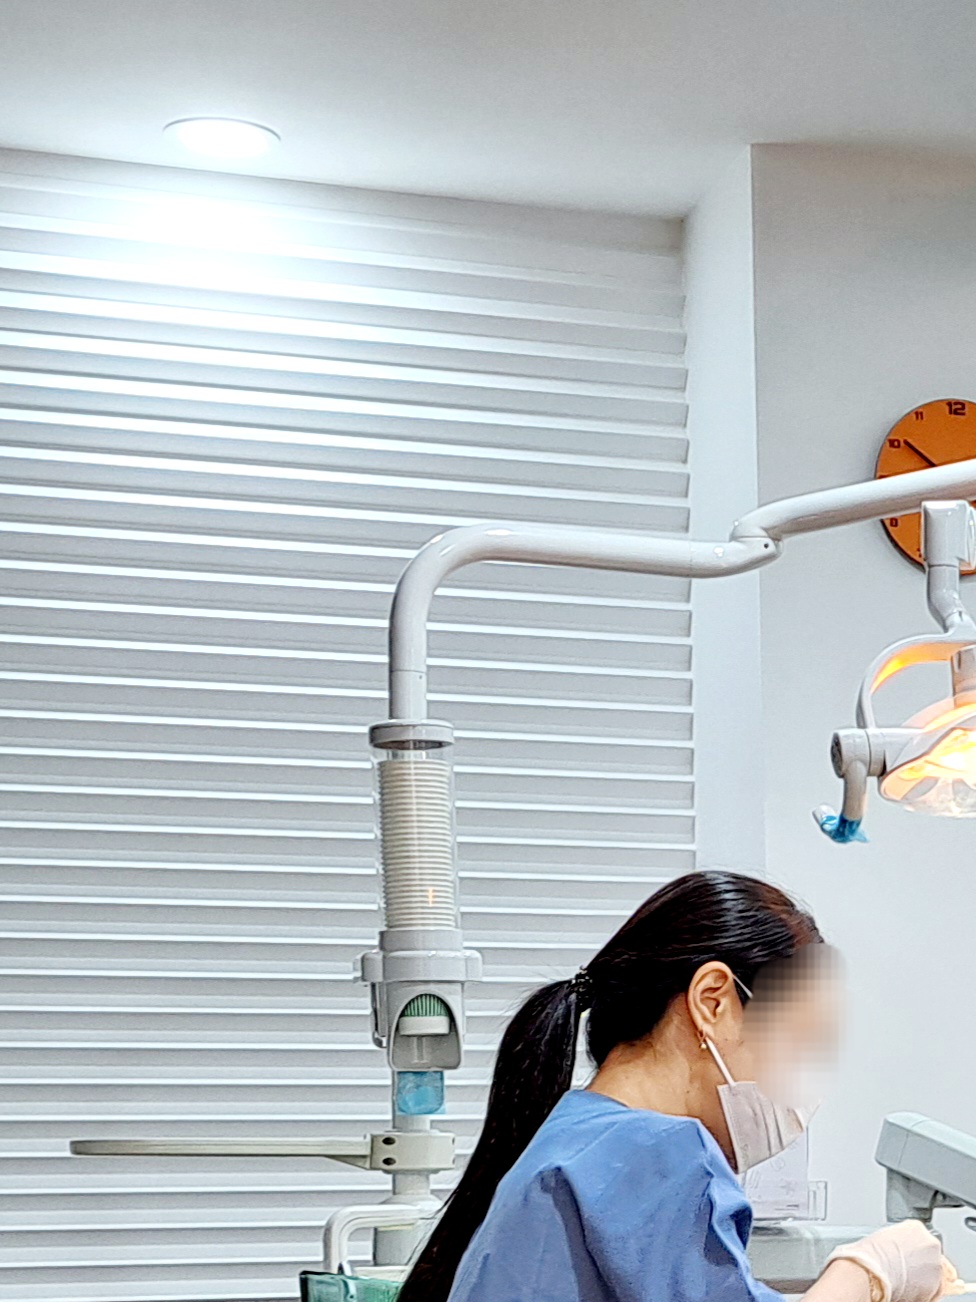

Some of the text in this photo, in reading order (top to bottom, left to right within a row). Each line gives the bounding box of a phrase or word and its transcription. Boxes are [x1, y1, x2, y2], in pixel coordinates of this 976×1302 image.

[946, 402, 966, 416] 12
[914, 411, 923, 421] 11
[888, 439, 901, 449] 10
